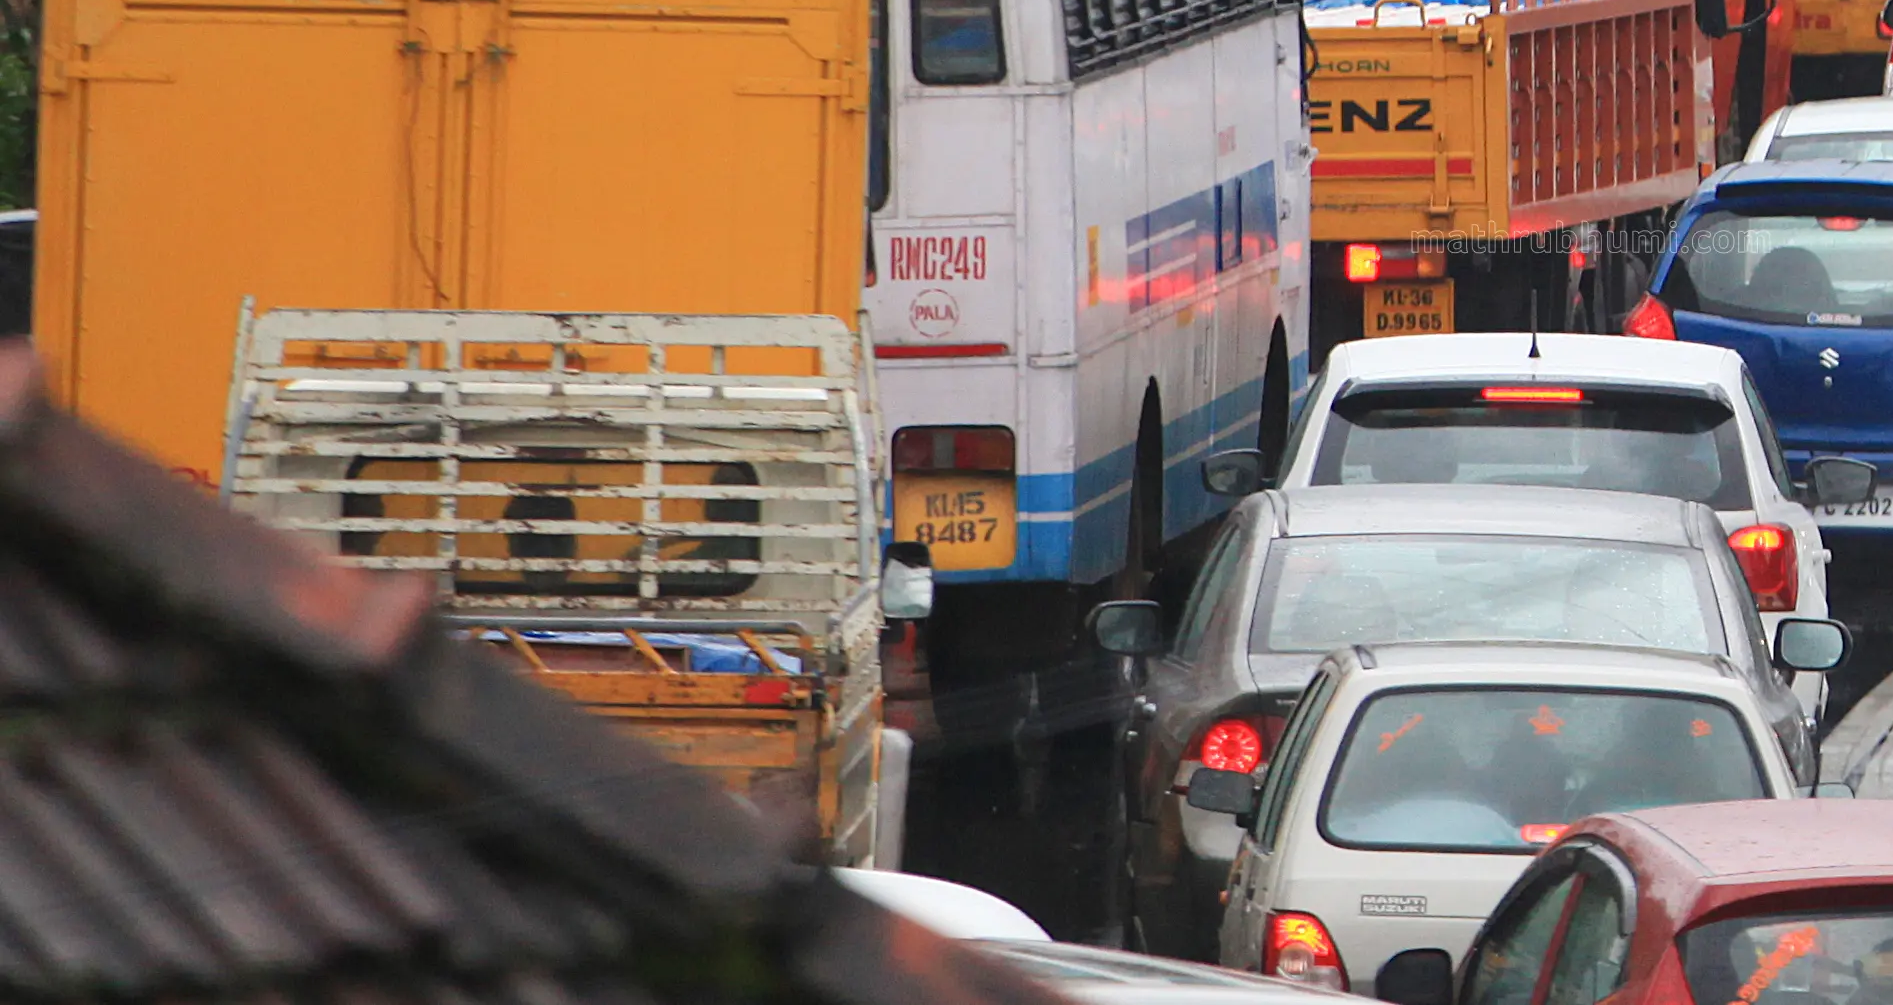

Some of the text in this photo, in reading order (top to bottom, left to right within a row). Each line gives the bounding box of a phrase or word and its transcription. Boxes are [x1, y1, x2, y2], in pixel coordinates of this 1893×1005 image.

[1310, 98, 1434, 133] ENZ
[890, 236, 986, 281] RNC249
[914, 305, 955, 321] PALA
[1844, 497, 1892, 516] 2202
[915, 517, 998, 545] 8487
[1362, 896, 1426, 905] MARUTI
[1362, 905, 1426, 913] SUZUKI
